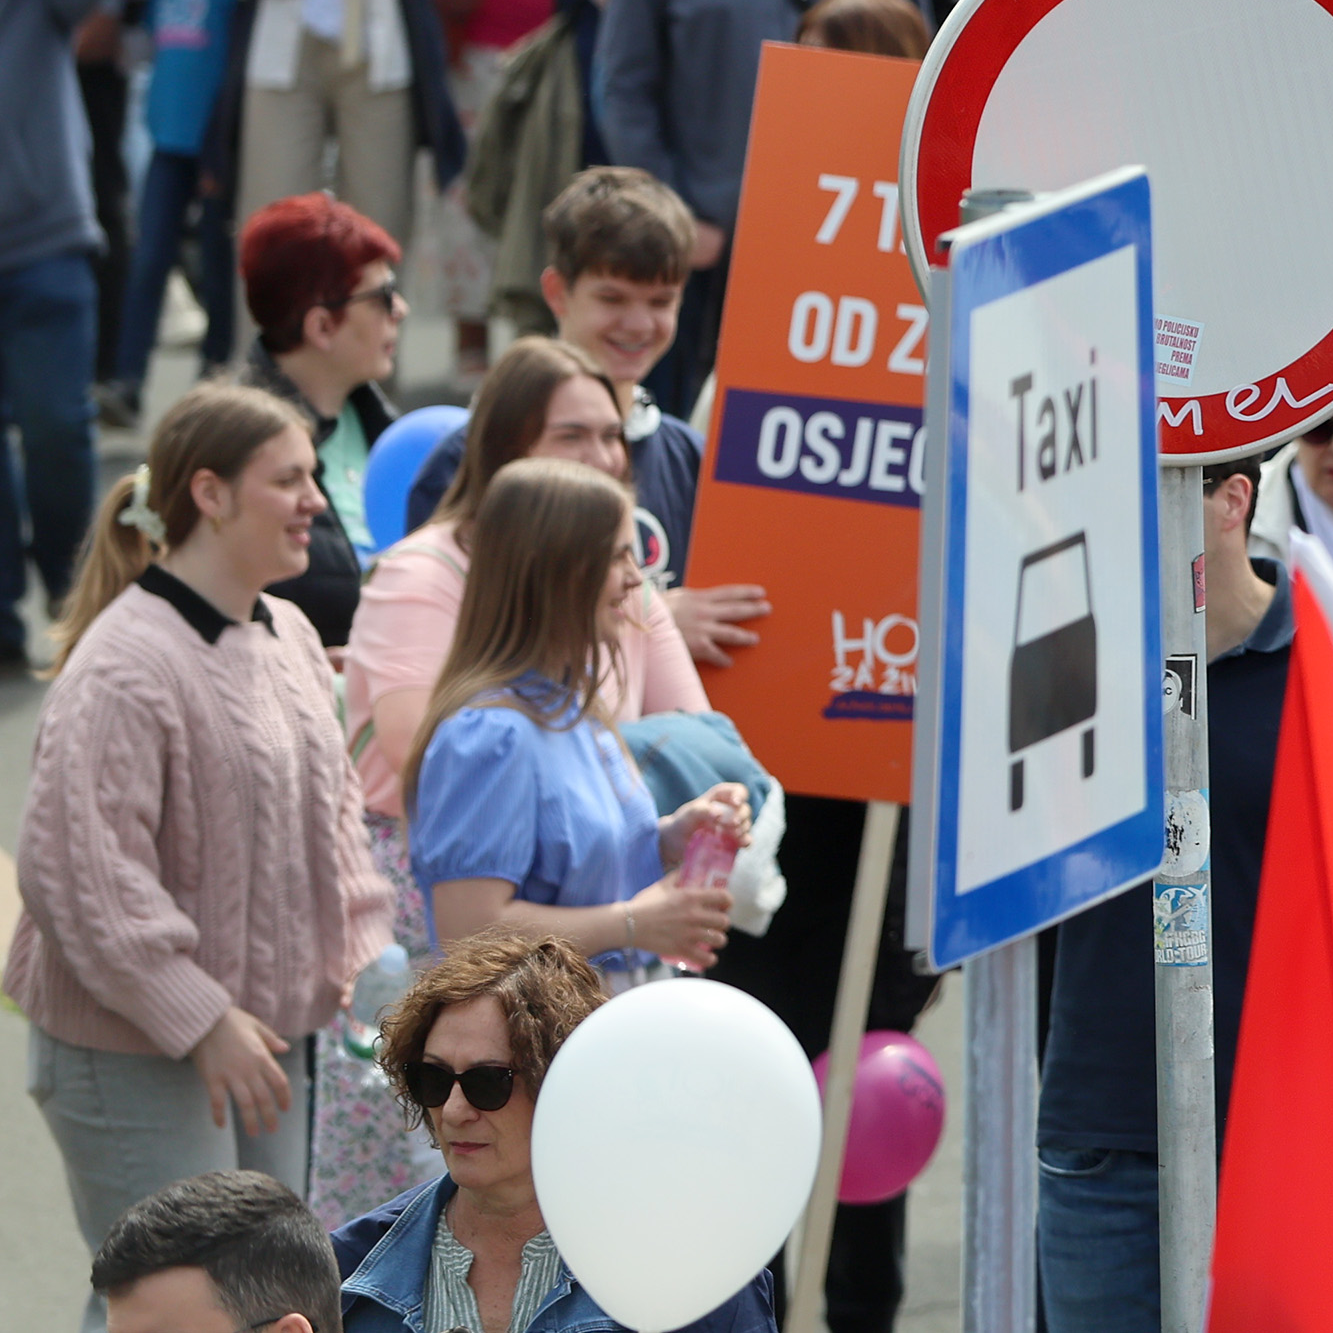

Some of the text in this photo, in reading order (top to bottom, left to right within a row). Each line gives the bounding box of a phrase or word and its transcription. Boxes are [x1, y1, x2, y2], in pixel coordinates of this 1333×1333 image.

[814, 173, 859, 245] 7
[788, 290, 878, 368] OD
[1163, 320, 1199, 338] POLICIJSKU
[1156, 332, 1196, 351] BRUTALNOST
[1170, 350, 1193, 365] PREMA
[1009, 346, 1097, 493] Taxi
[1179, 943, 1208, 963] TOUR
